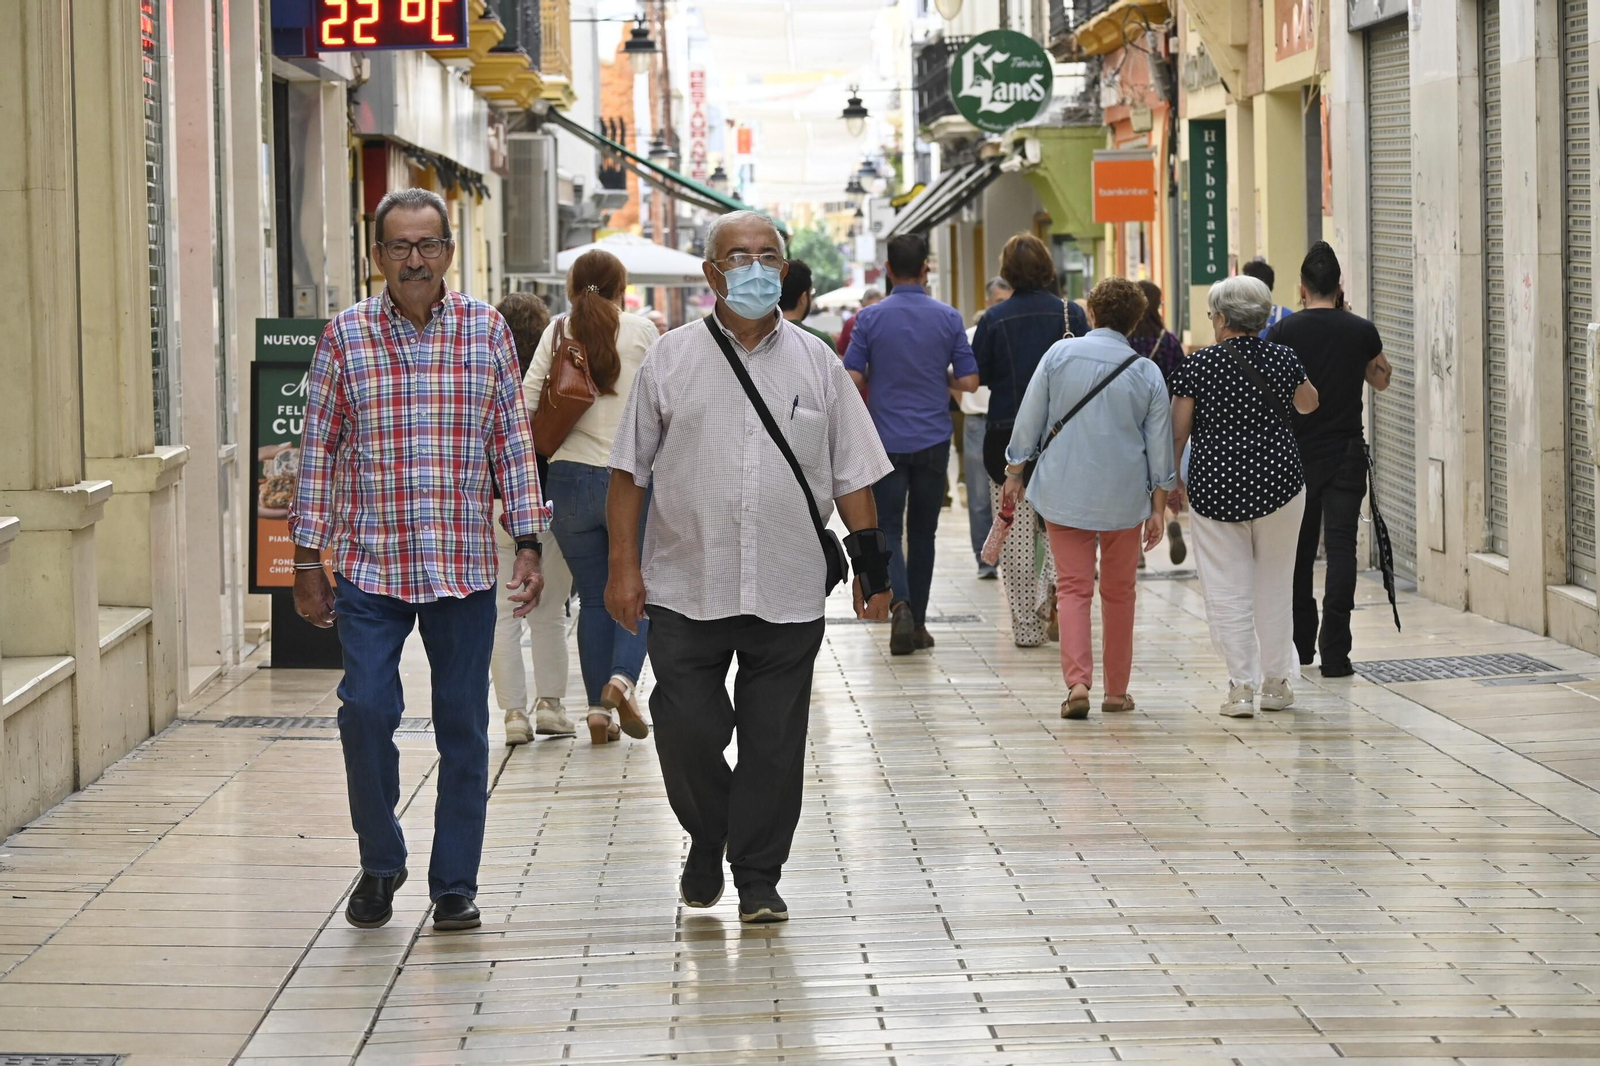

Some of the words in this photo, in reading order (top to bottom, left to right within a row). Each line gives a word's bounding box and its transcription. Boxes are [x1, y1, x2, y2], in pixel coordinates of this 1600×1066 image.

[322, 0, 379, 45] 22
[1098, 187, 1149, 197] bankinter
[1203, 129, 1217, 274] Herbolario
[263, 334, 317, 346] NUEVOS
